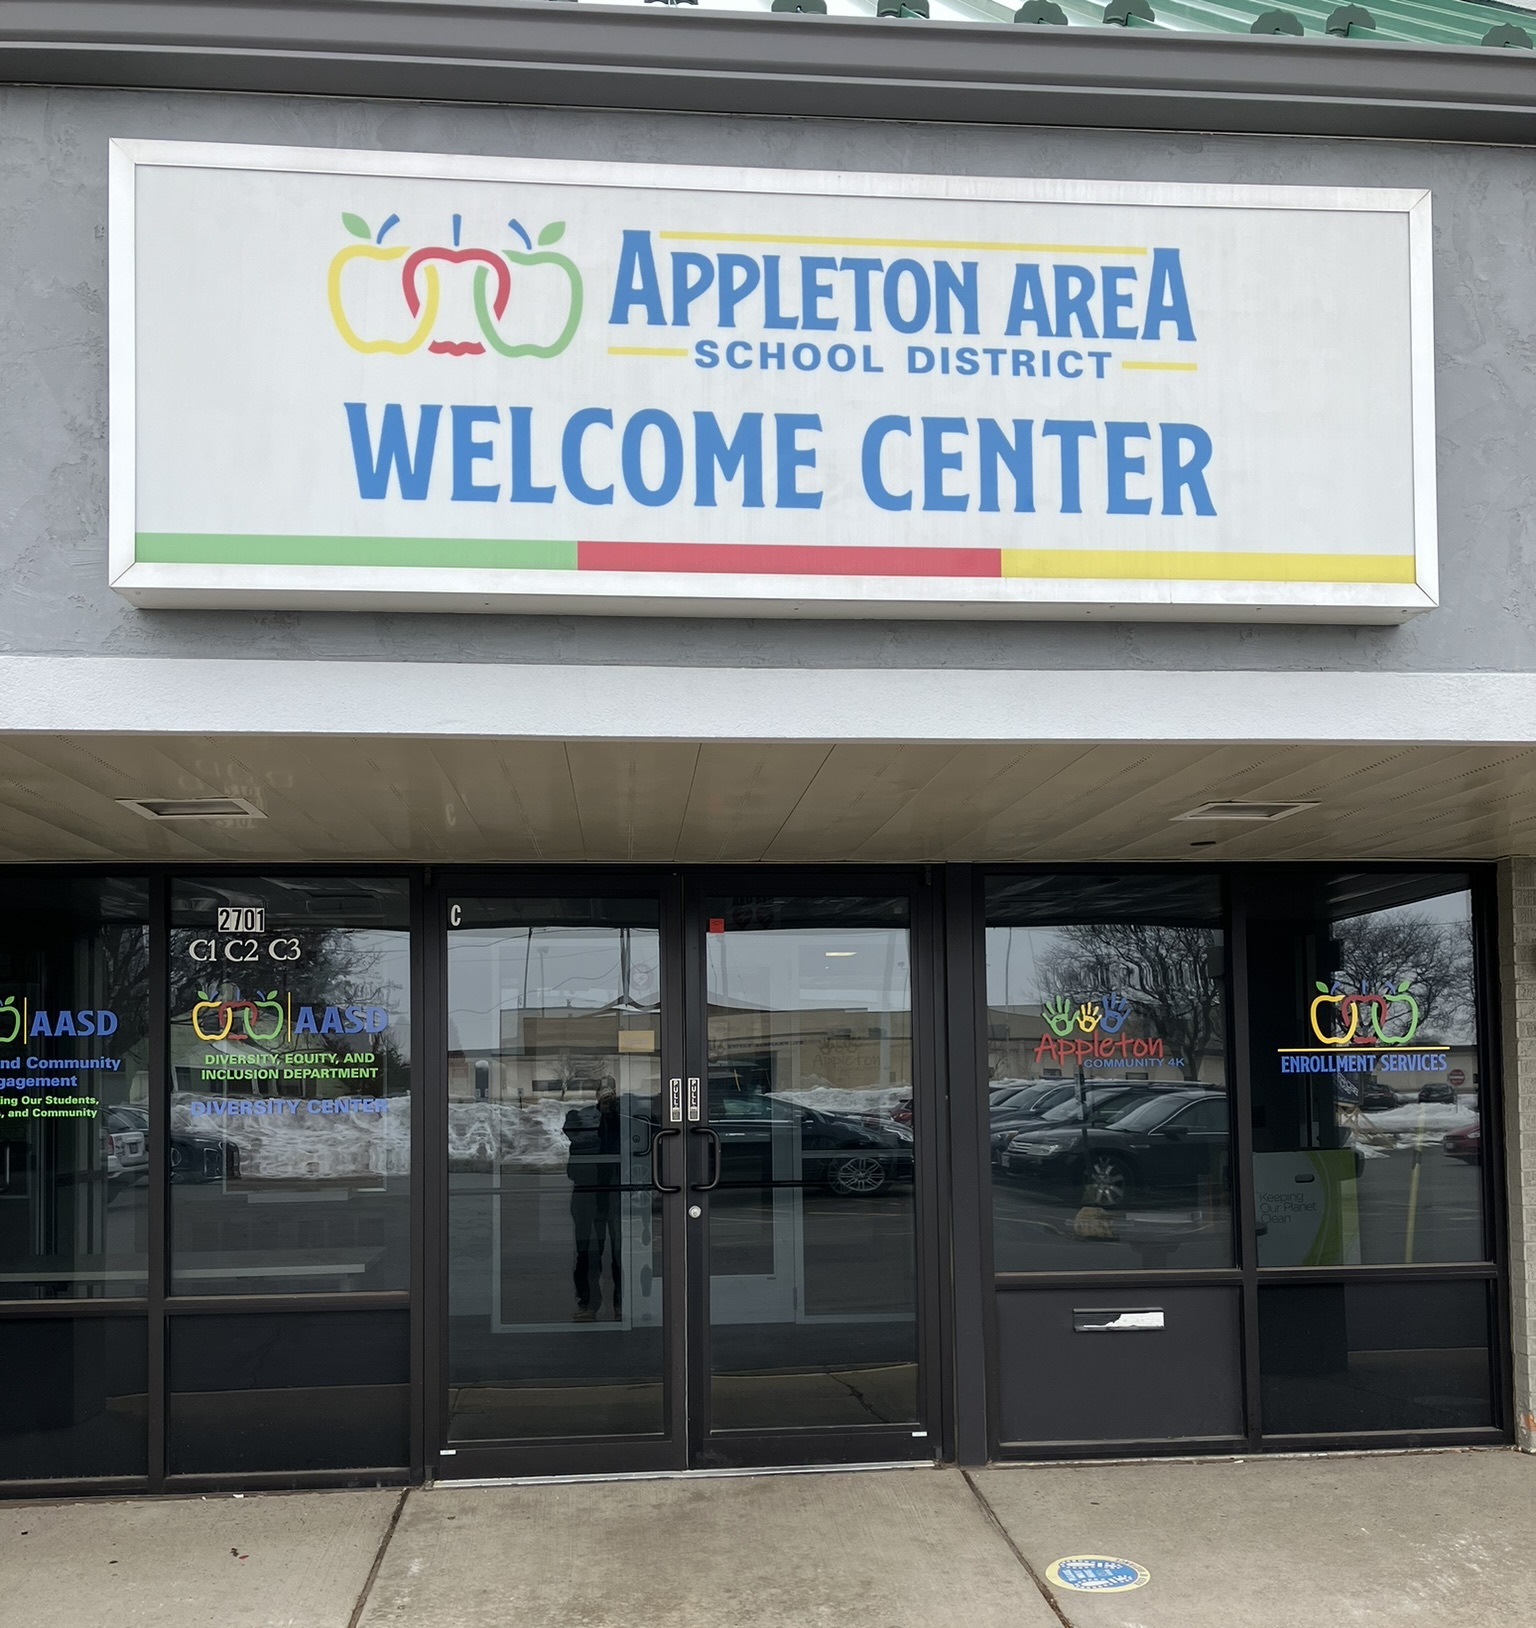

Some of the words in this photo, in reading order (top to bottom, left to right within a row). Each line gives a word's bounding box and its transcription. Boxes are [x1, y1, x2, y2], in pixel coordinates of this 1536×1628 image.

[608, 229, 980, 335] APPLETON
[1004, 247, 1197, 341] AREA
[694, 339, 884, 373] SCHOOL
[907, 345, 1112, 379] DISTRICT
[344, 402, 824, 510] WELCOME
[861, 414, 1218, 517] CENTER
[218, 908, 264, 931] 2701
[450, 904, 461, 926] C
[188, 939, 217, 961] C1
[224, 939, 259, 962] C2
[268, 938, 301, 961] C3
[29, 1010, 118, 1036] AASD
[294, 1006, 388, 1034] AASD
[1034, 1030, 1163, 1066] Appleton
[26, 1056, 121, 1072] Community
[204, 1053, 281, 1066] DIVERSITY,
[285, 1053, 339, 1066] EQUITY,
[343, 1052, 375, 1063] AND
[1083, 1058, 1164, 1068] COMMUNITY
[1167, 1057, 1185, 1067] 4K
[1281, 1054, 1377, 1073] ENROLLMENT
[1380, 1053, 1447, 1071] SERVICES
[201, 1068, 280, 1080] INCLUSION
[283, 1067, 379, 1079] DEPARTMENT
[21, 1095, 42, 1105] Our
[45, 1095, 100, 1106] Students,
[190, 1099, 299, 1116] DIVERSITY
[307, 1098, 388, 1114] CENTER
[8, 1108, 29, 1117] and
[32, 1108, 98, 1119] Community
[1260, 1192, 1304, 1203] Keeping
[1260, 1202, 1281, 1213] Our
[1284, 1202, 1317, 1212] Planet
[1261, 1213, 1292, 1223] Clean
